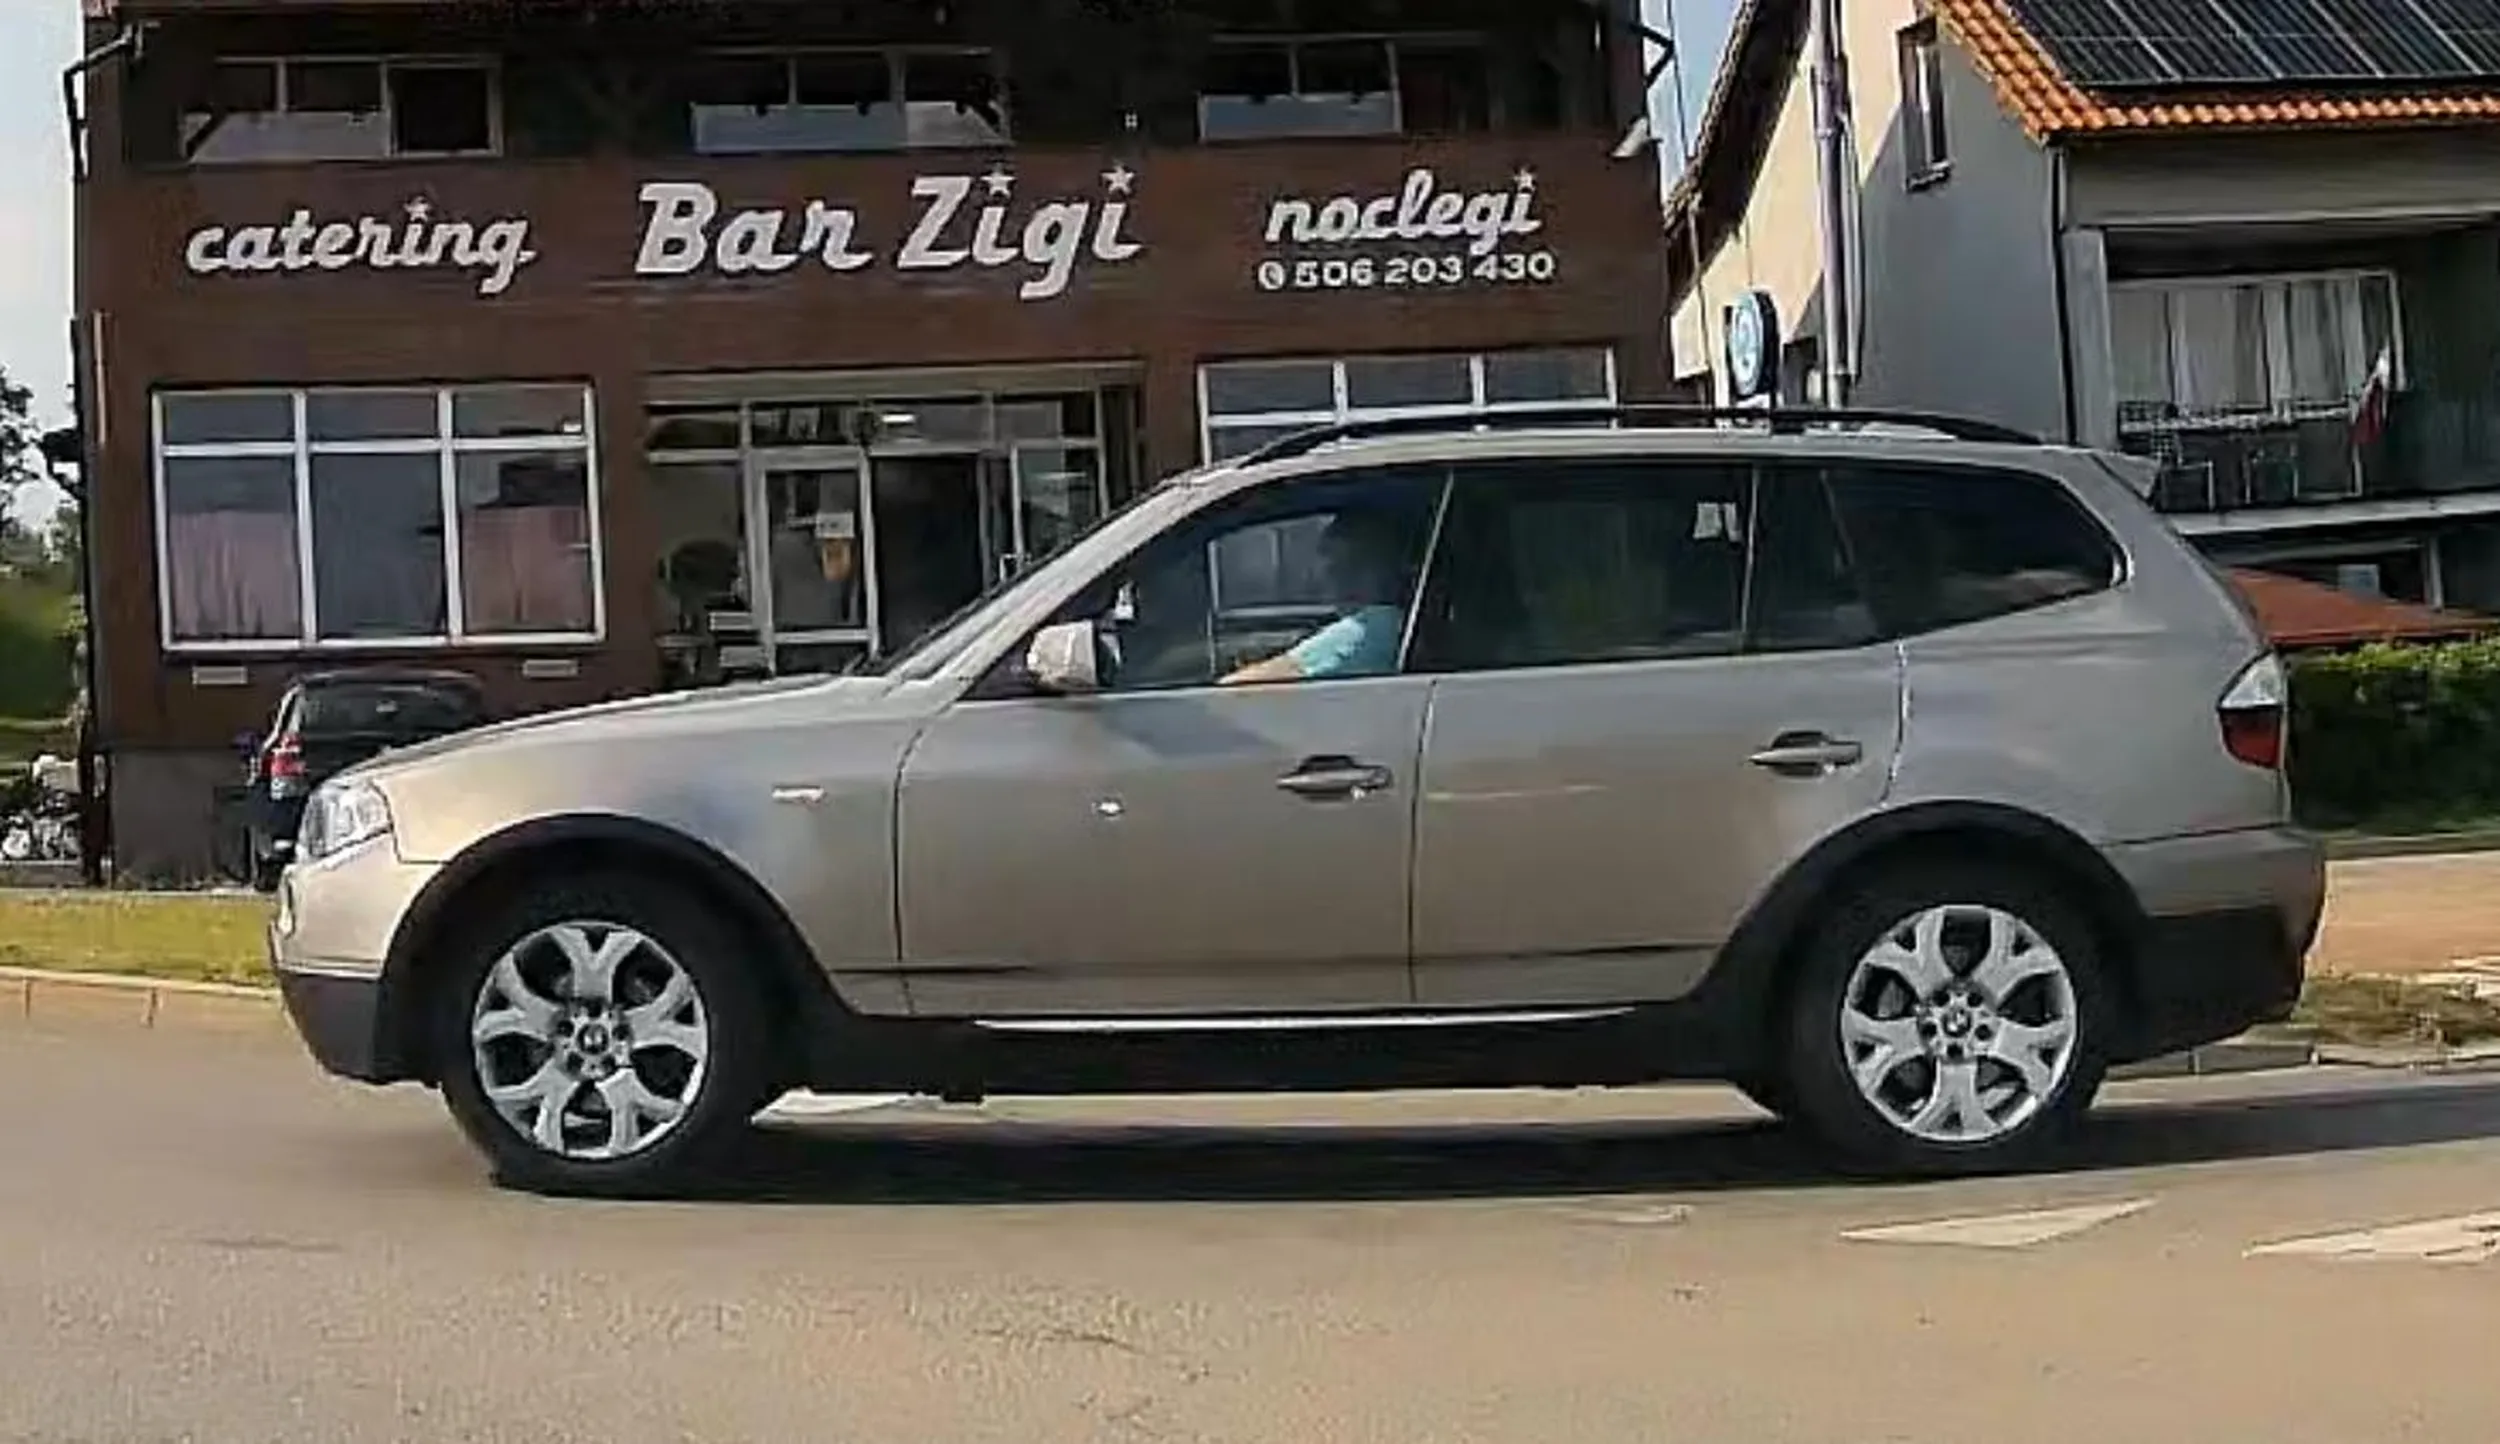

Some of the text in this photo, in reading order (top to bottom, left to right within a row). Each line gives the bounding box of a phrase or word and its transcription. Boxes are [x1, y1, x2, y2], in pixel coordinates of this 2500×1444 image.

[186, 197, 537, 293] catering
[636, 165, 1142, 300] Bar Zigi
[1265, 168, 1542, 256] noclegi
[1295, 252, 1554, 287] 506 203 430
